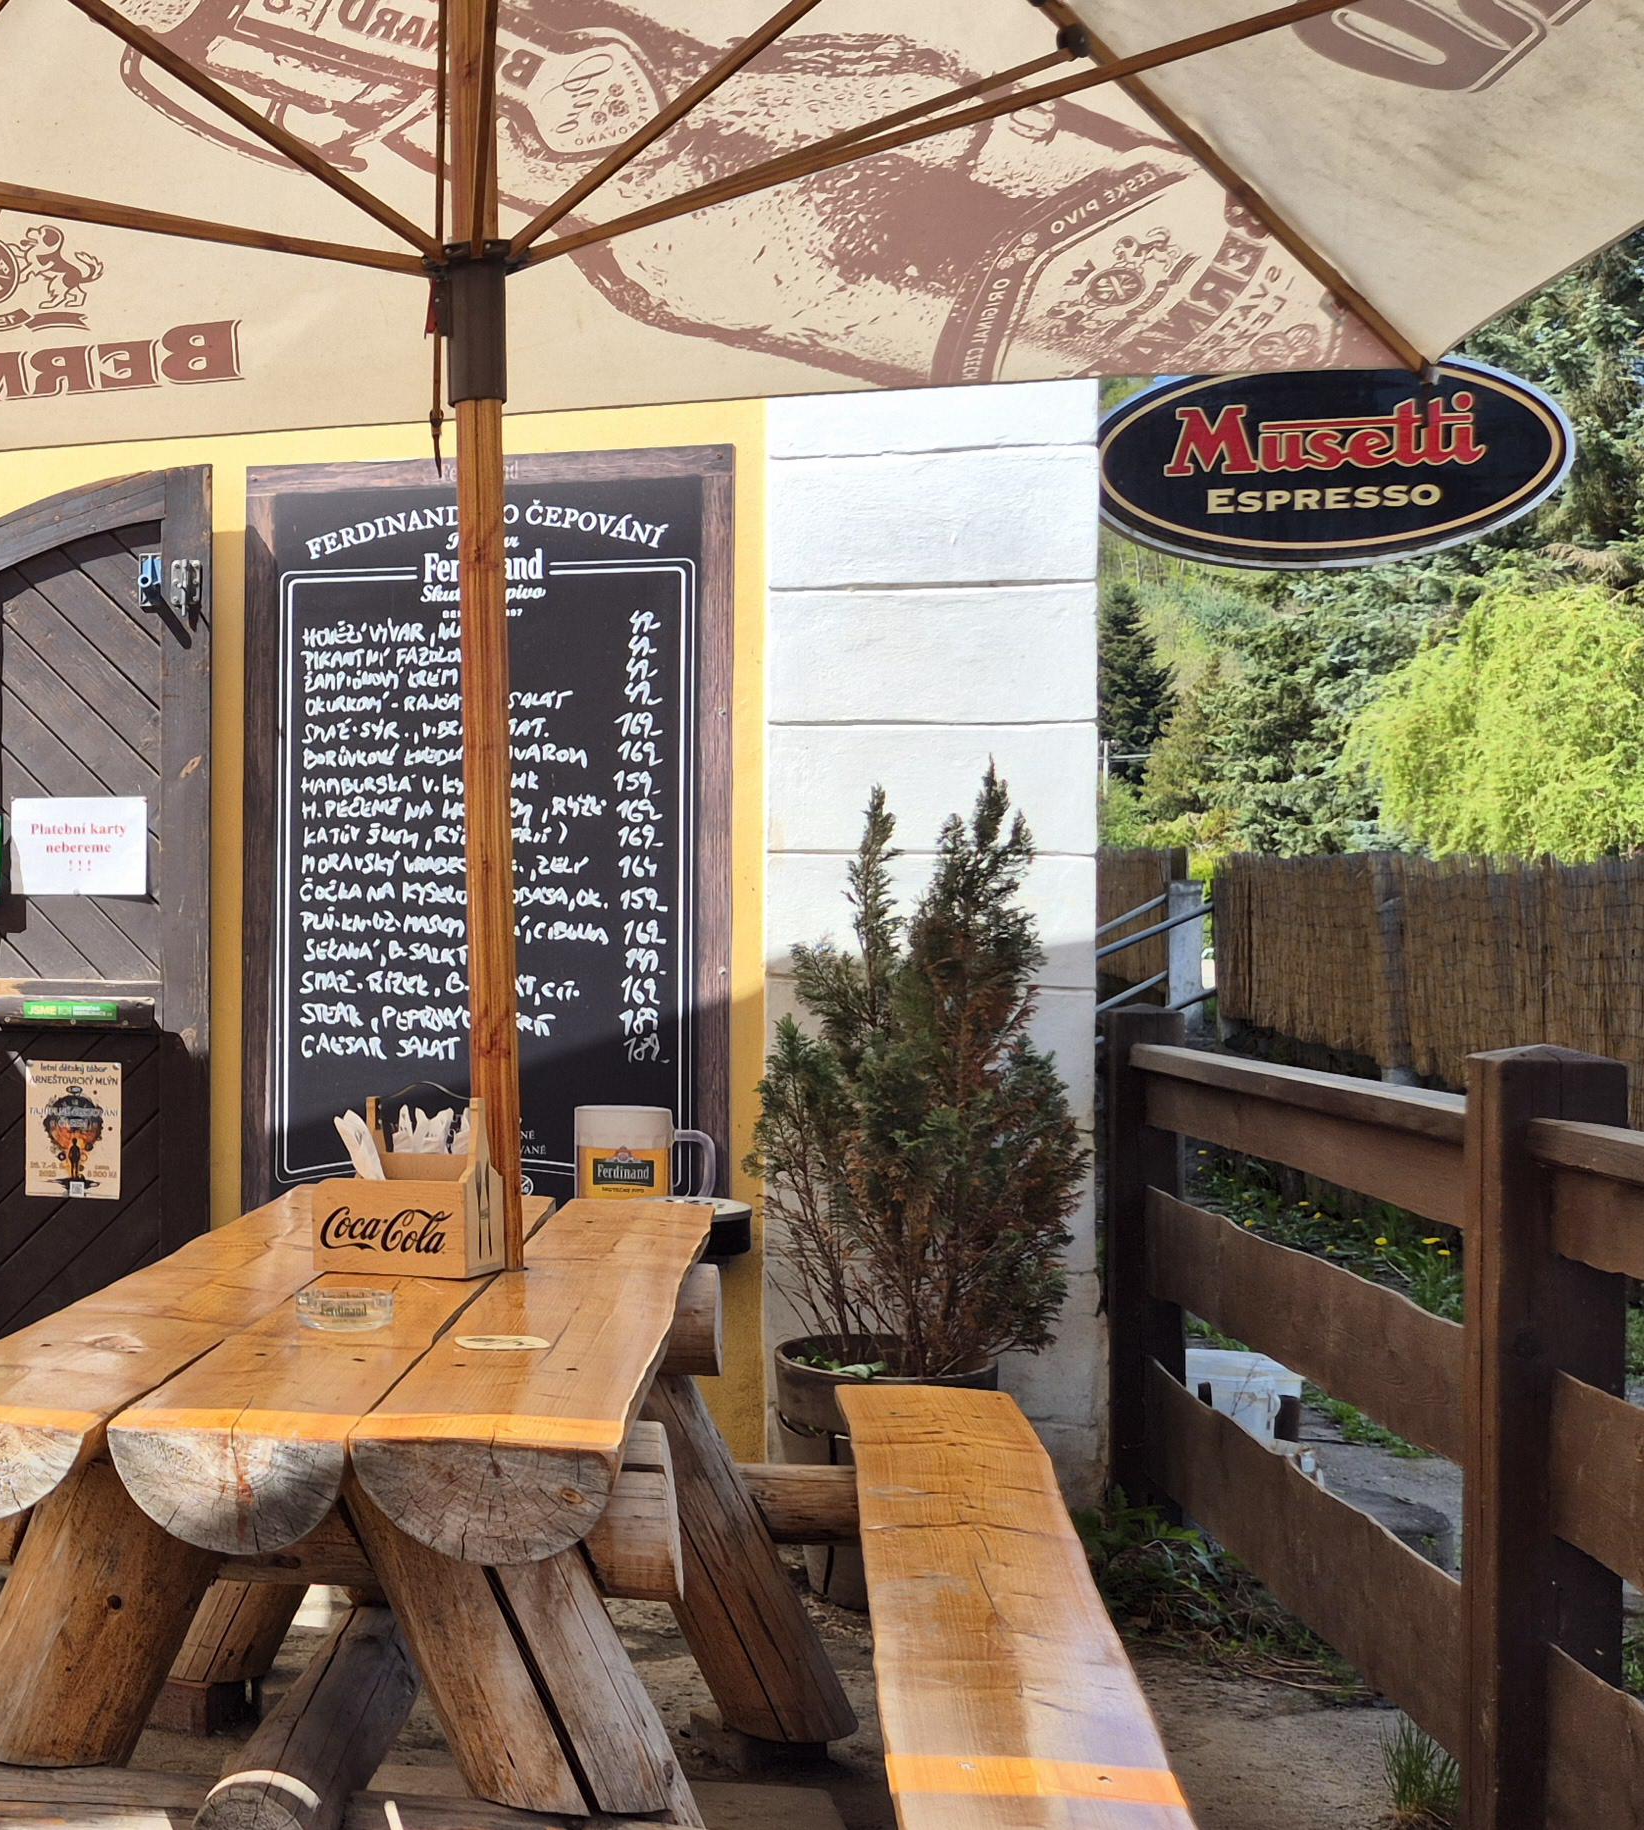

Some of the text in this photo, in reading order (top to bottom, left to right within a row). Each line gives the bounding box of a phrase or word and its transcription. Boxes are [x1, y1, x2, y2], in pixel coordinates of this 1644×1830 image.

[1164, 391, 1487, 478] Musetti
[1206, 483, 1443, 516] ESPRESSO
[524, 498, 670, 550] ČEPOVÁNÍ
[423, 547, 545, 584] Ferand
[31, 822, 126, 837] Platební karty
[45, 842, 112, 854] nebereme
[366, 881, 396, 903] NA
[301, 1032, 388, 1061] CAESAR
[597, 1162, 651, 1181] Ferdinand
